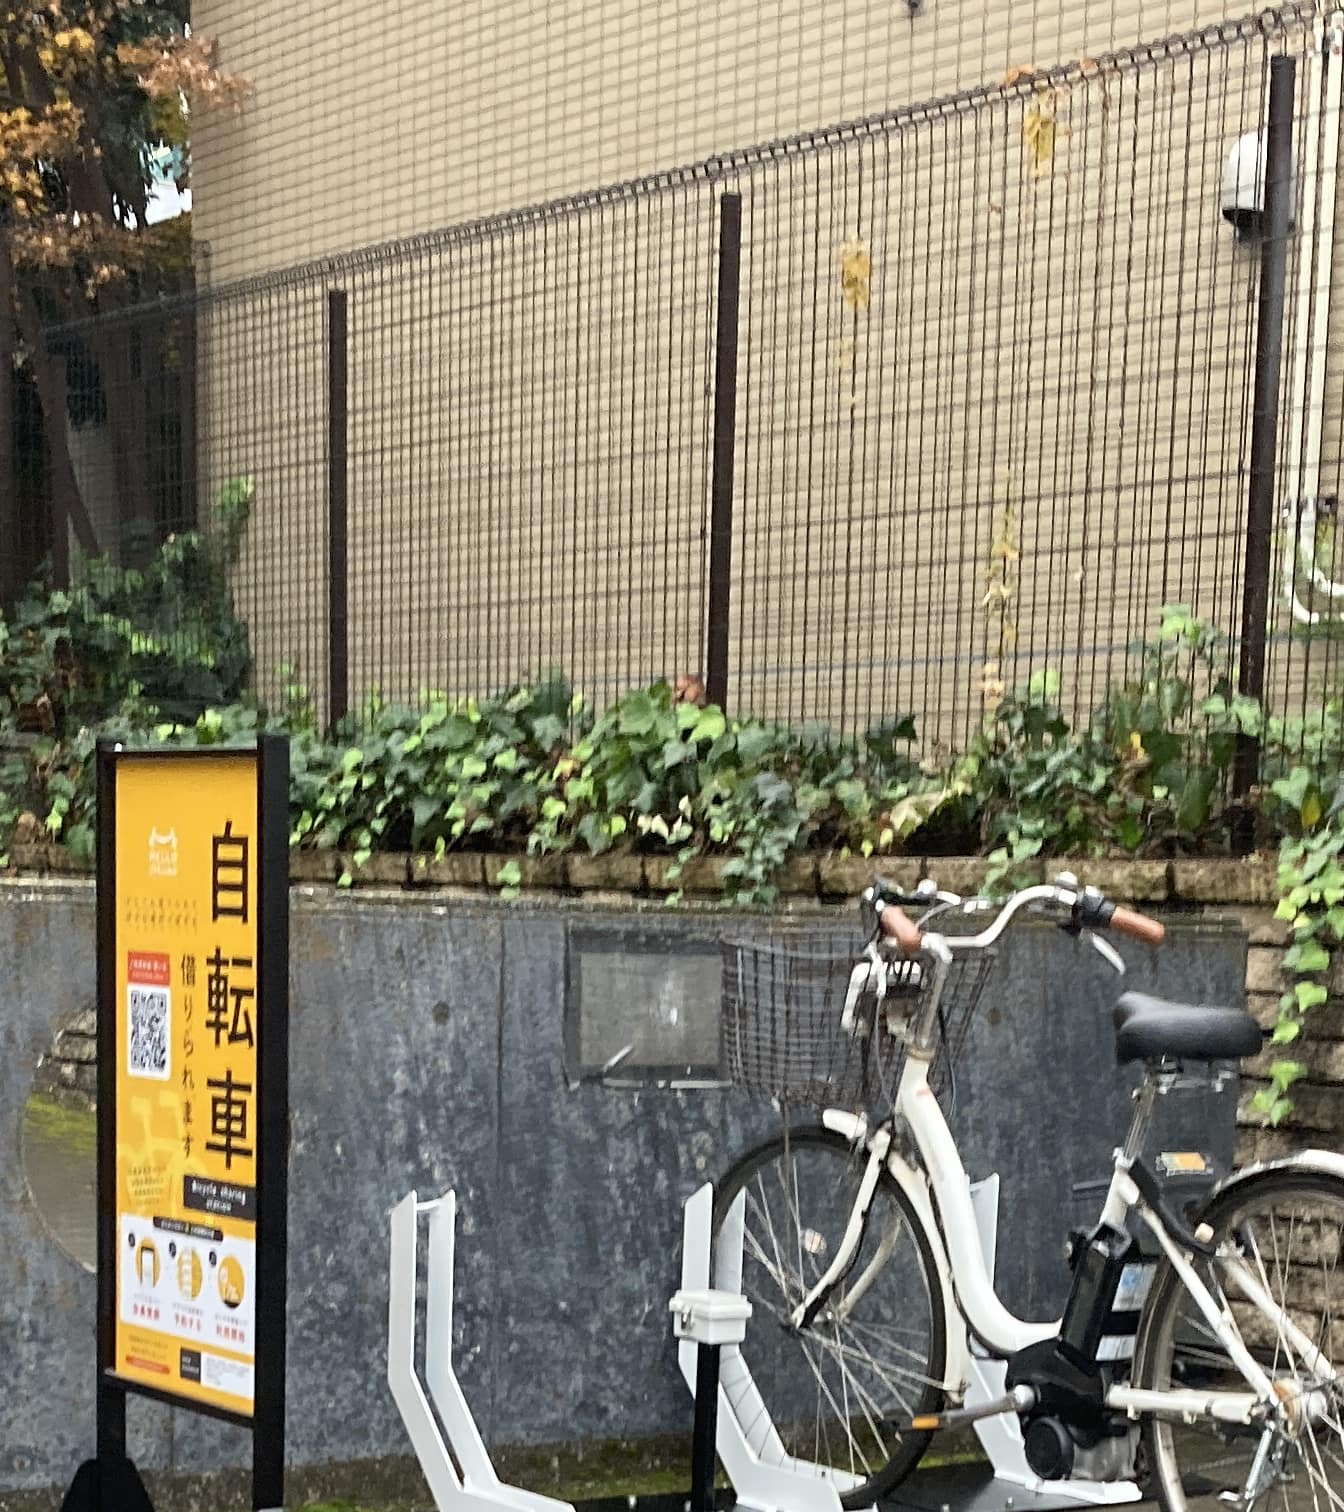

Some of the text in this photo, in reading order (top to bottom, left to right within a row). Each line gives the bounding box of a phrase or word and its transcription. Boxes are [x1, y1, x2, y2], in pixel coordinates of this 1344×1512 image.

[180, 951, 197, 1158] 借りられます
[206, 819, 255, 1170] 自転車
